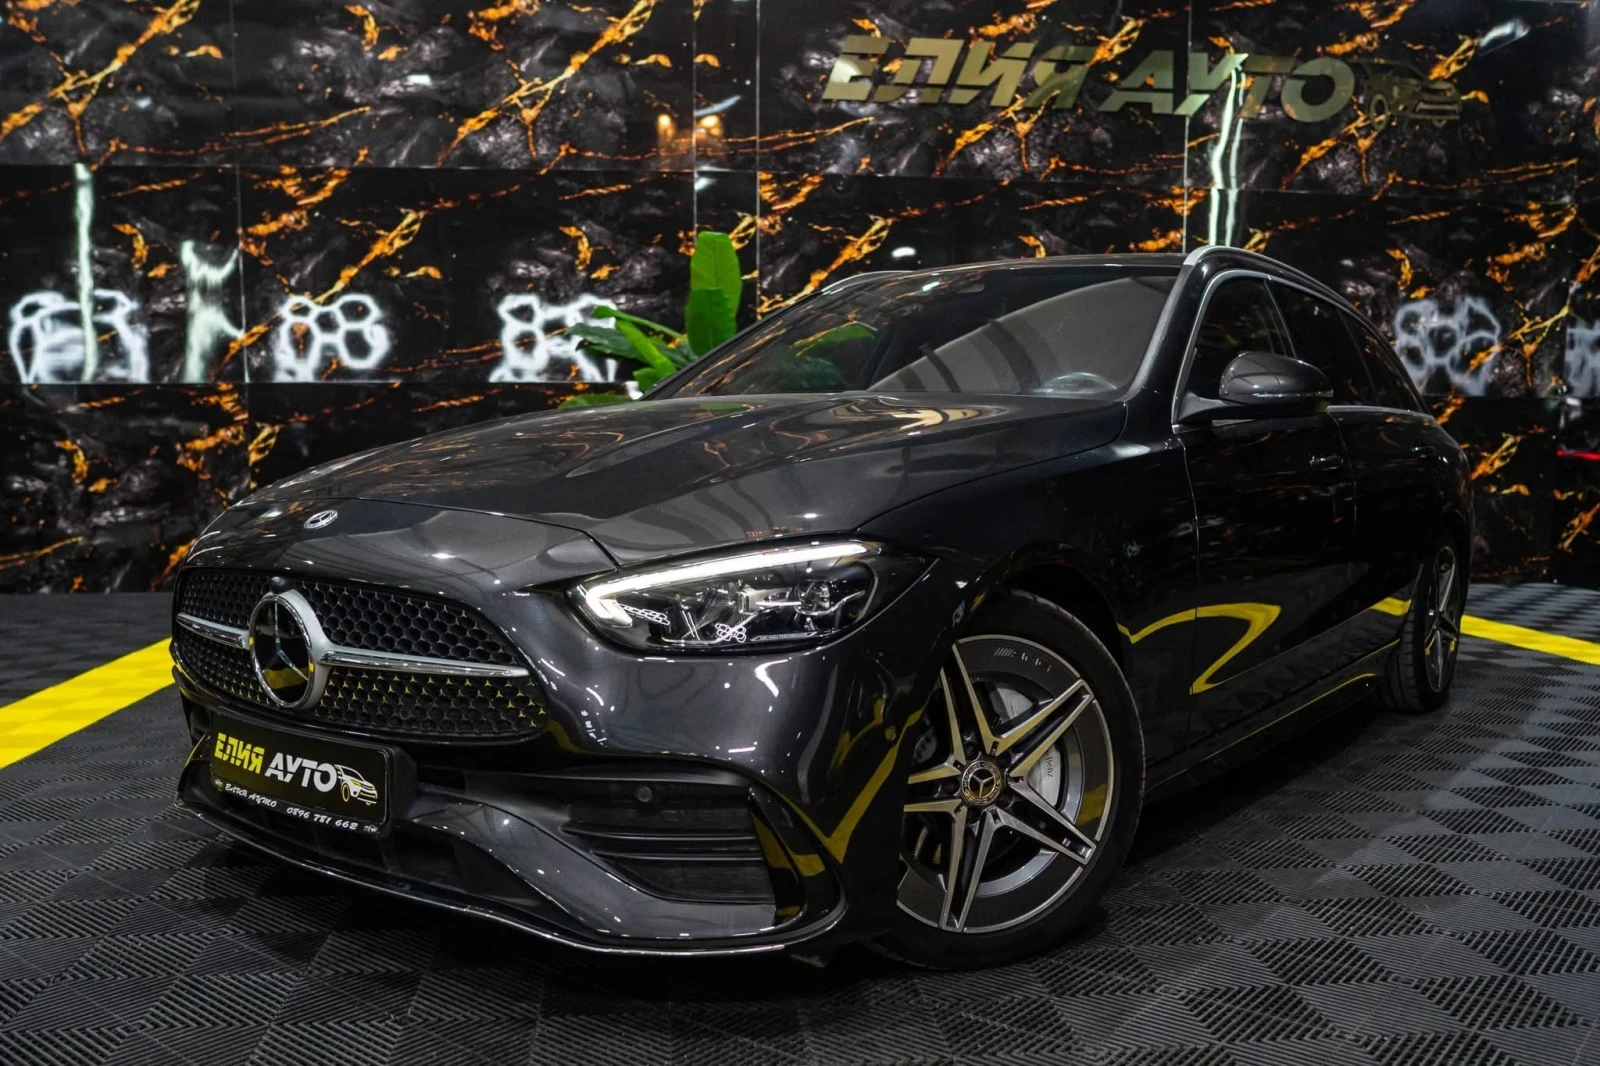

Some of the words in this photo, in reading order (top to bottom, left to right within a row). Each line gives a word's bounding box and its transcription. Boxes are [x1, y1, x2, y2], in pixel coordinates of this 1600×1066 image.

[821, 34, 1097, 109] ЕЛИЯ
[1100, 50, 1356, 122] АУТО
[214, 732, 265, 774] ЕЛИЯ
[264, 752, 337, 793] АУТО
[286, 807, 310, 819] 0896
[313, 814, 332, 824] 781
[335, 820, 358, 830] 662
